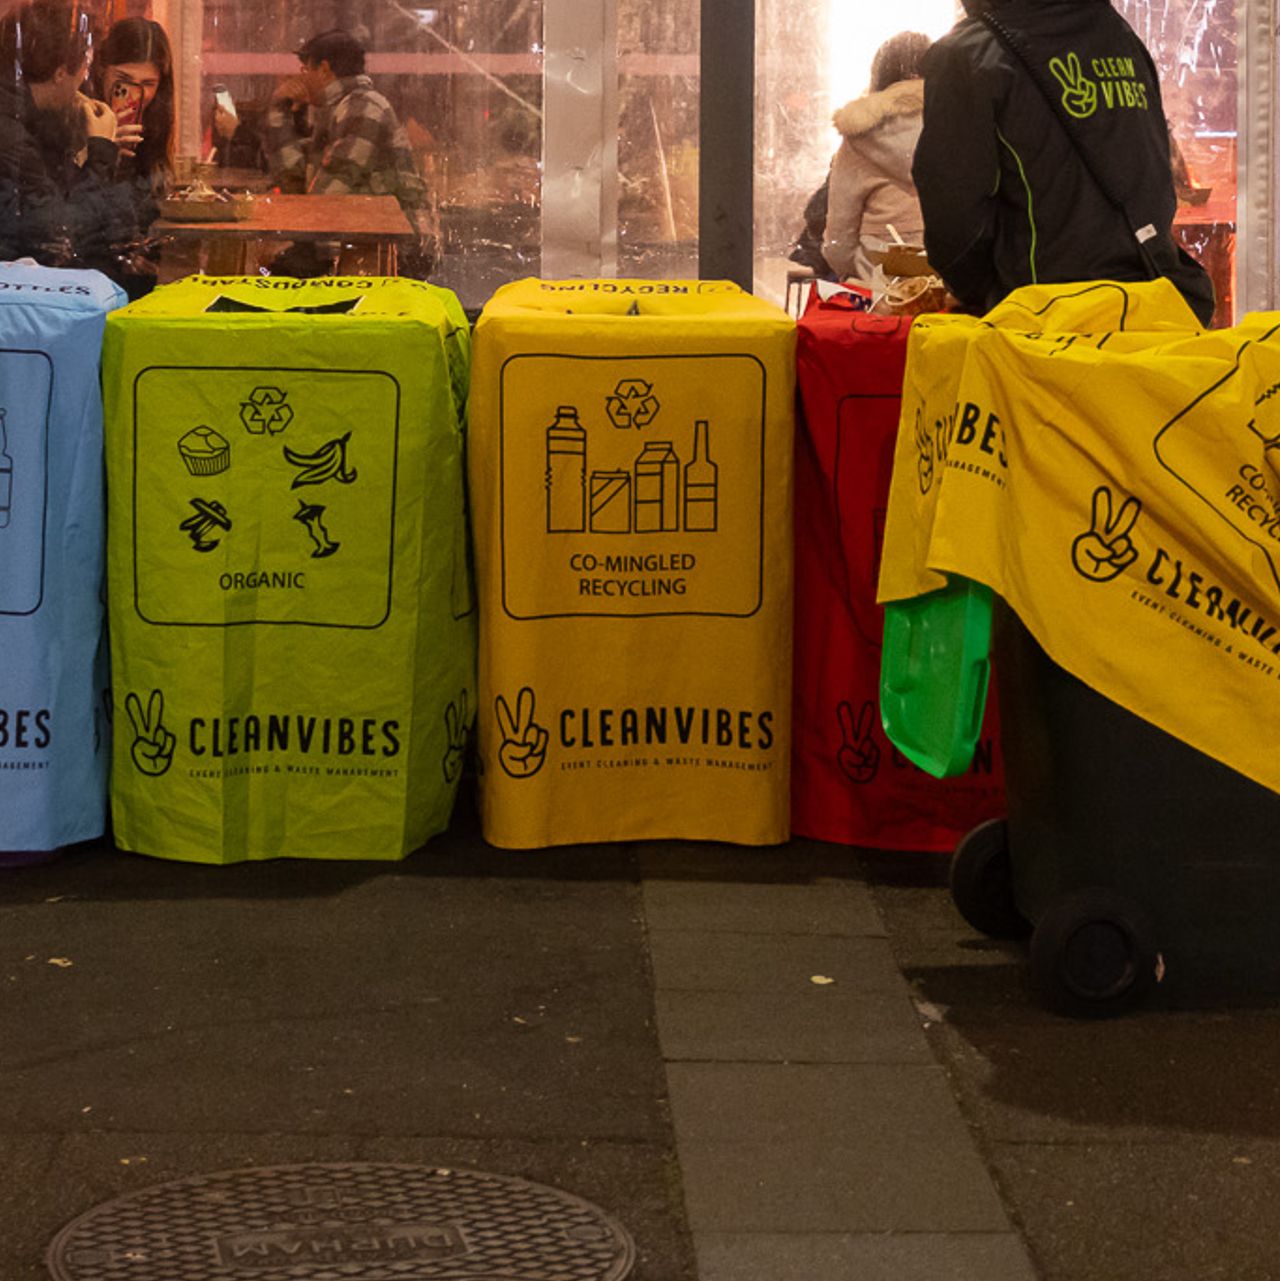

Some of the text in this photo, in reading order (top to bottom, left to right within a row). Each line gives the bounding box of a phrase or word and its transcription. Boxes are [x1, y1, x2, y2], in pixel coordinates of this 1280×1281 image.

[1091, 57, 1136, 78] CLEAN
[1100, 80, 1148, 110] VIBES
[177, 276, 374, 291] COMPOSTAB
[569, 553, 697, 572] CO-MINGLED
[219, 571, 305, 590] ORGANIC
[579, 578, 687, 596] RECYCLING
[1131, 591, 1165, 612] EVENT
[1169, 612, 1221, 647] CLEANING
[1238, 651, 1273, 675] WASTE
[189, 714, 401, 757] CLEANVIBES
[560, 707, 774, 750] CLEANVIBES
[596, 758, 648, 768] CLEANING
[666, 757, 701, 767] WASTE
[233, 1231, 453, 1257] DURHAM
